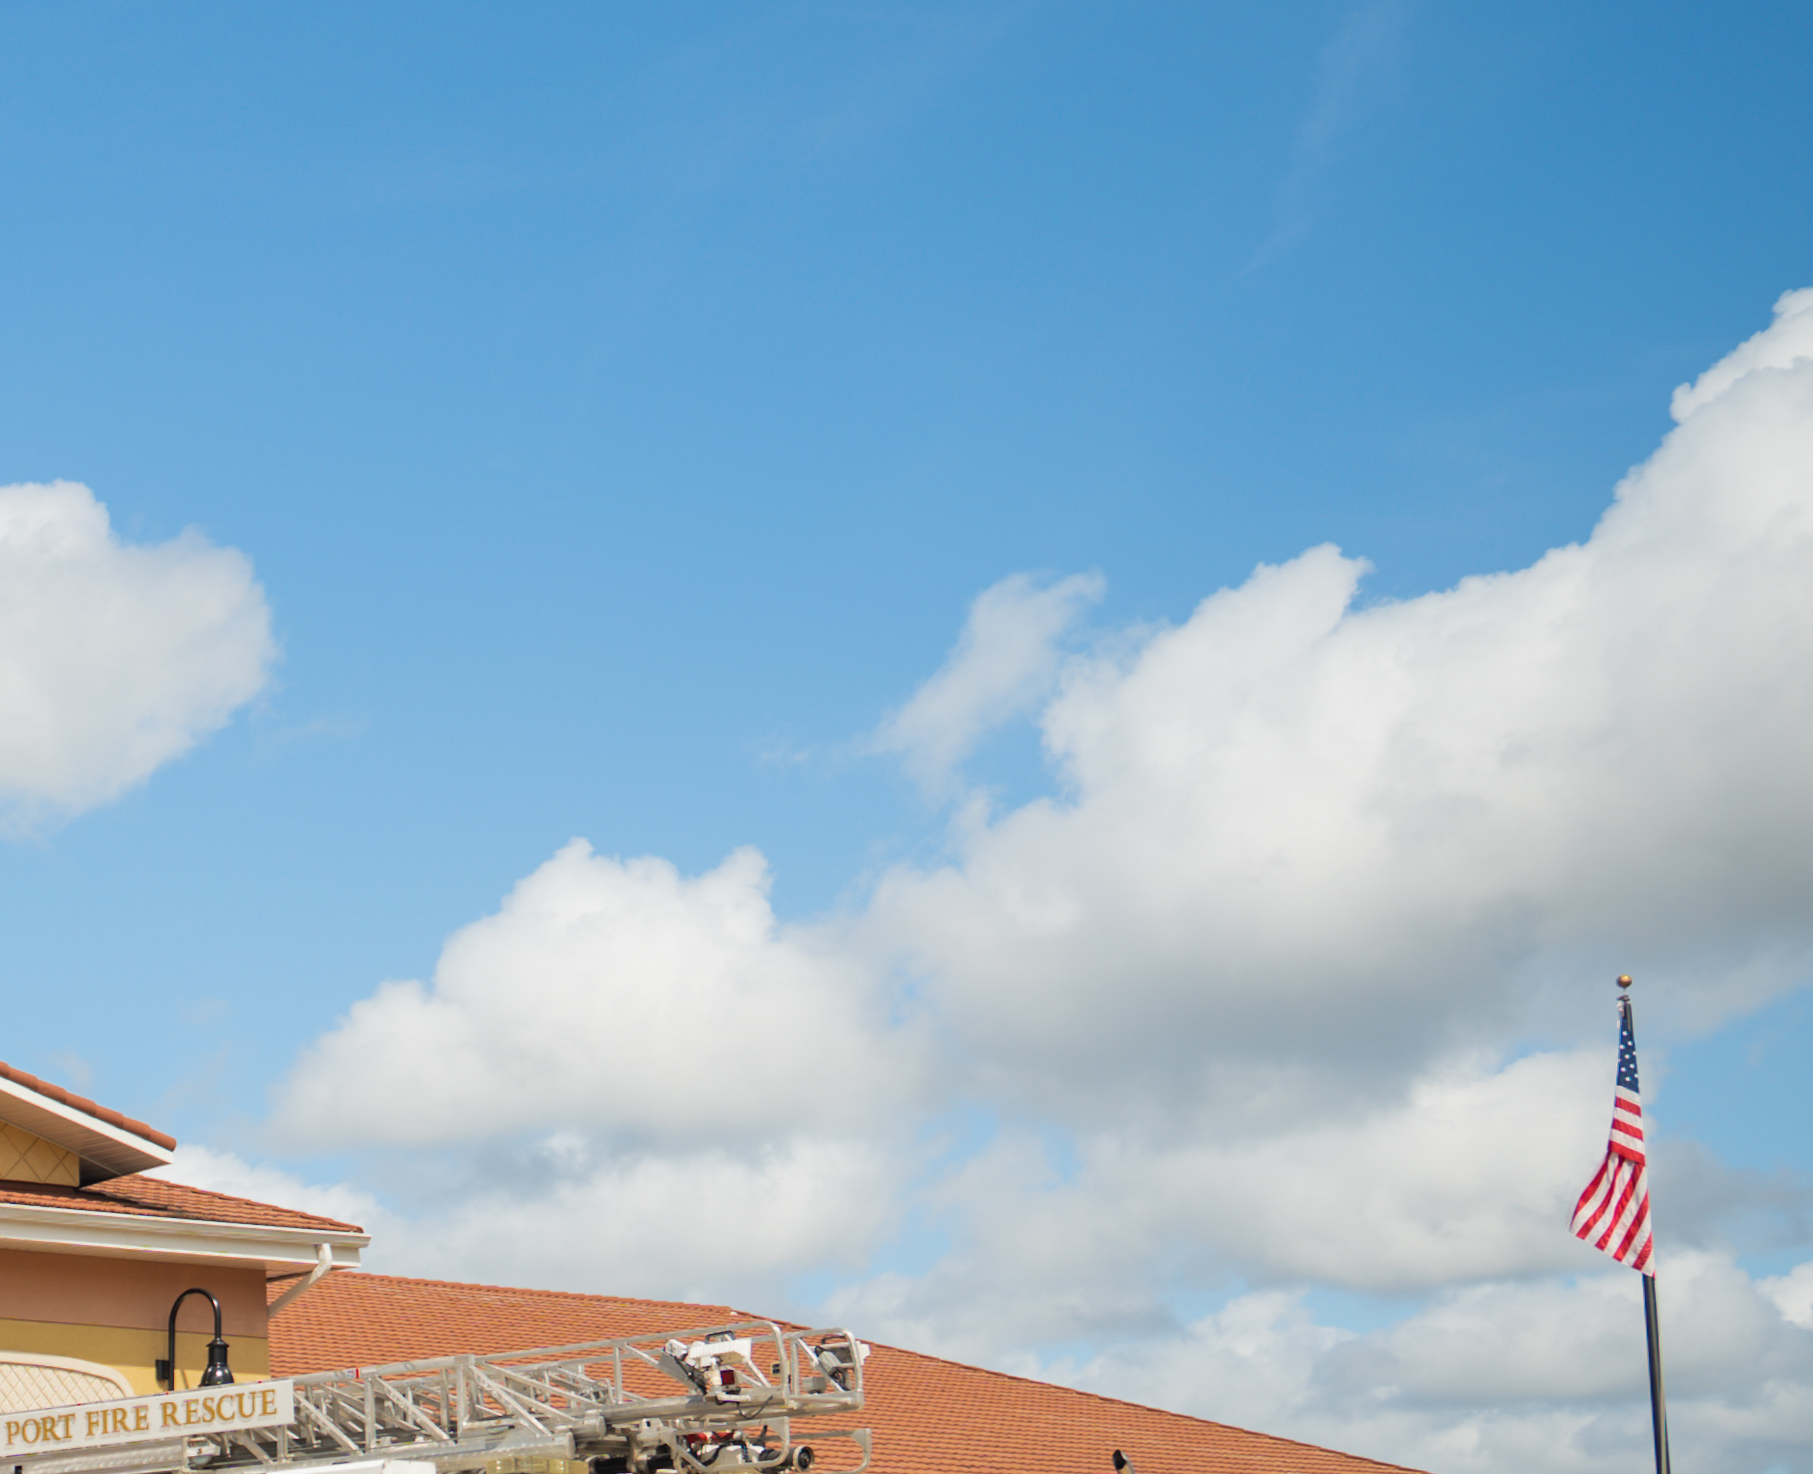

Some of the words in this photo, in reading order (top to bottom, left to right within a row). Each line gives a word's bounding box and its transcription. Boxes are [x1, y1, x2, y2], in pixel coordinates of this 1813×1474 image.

[5, 1413, 74, 1446] PORT
[85, 1404, 150, 1437] FIRE
[161, 1389, 277, 1428] RESCUE
